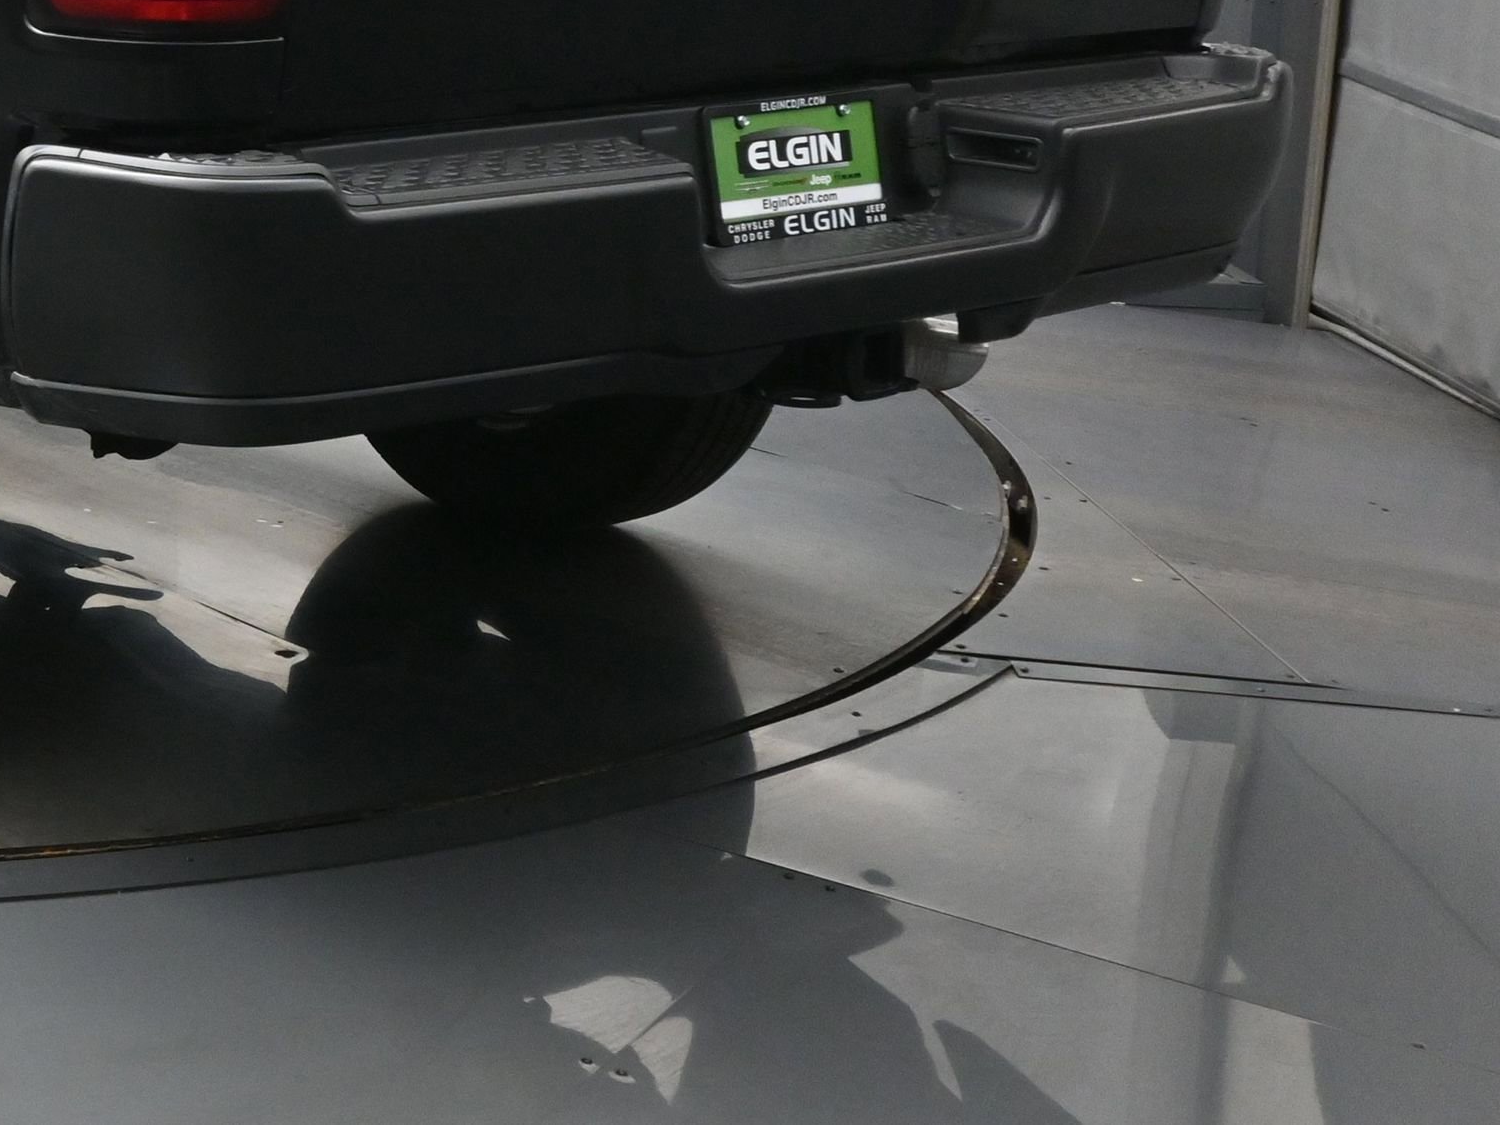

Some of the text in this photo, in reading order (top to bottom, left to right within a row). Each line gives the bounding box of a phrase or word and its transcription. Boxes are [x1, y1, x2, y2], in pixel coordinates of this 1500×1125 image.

[760, 96, 827, 112] ELGINCDJR.COM
[747, 132, 843, 171] ELGIN
[809, 174, 832, 186] Jeep
[762, 192, 838, 211] ElginCDJR.com
[864, 203, 887, 214] JEEP
[783, 207, 856, 235] ELGIN
[866, 213, 888, 223] RAM
[727, 219, 775, 234] CHRYSLER
[733, 230, 772, 244] DODGE
